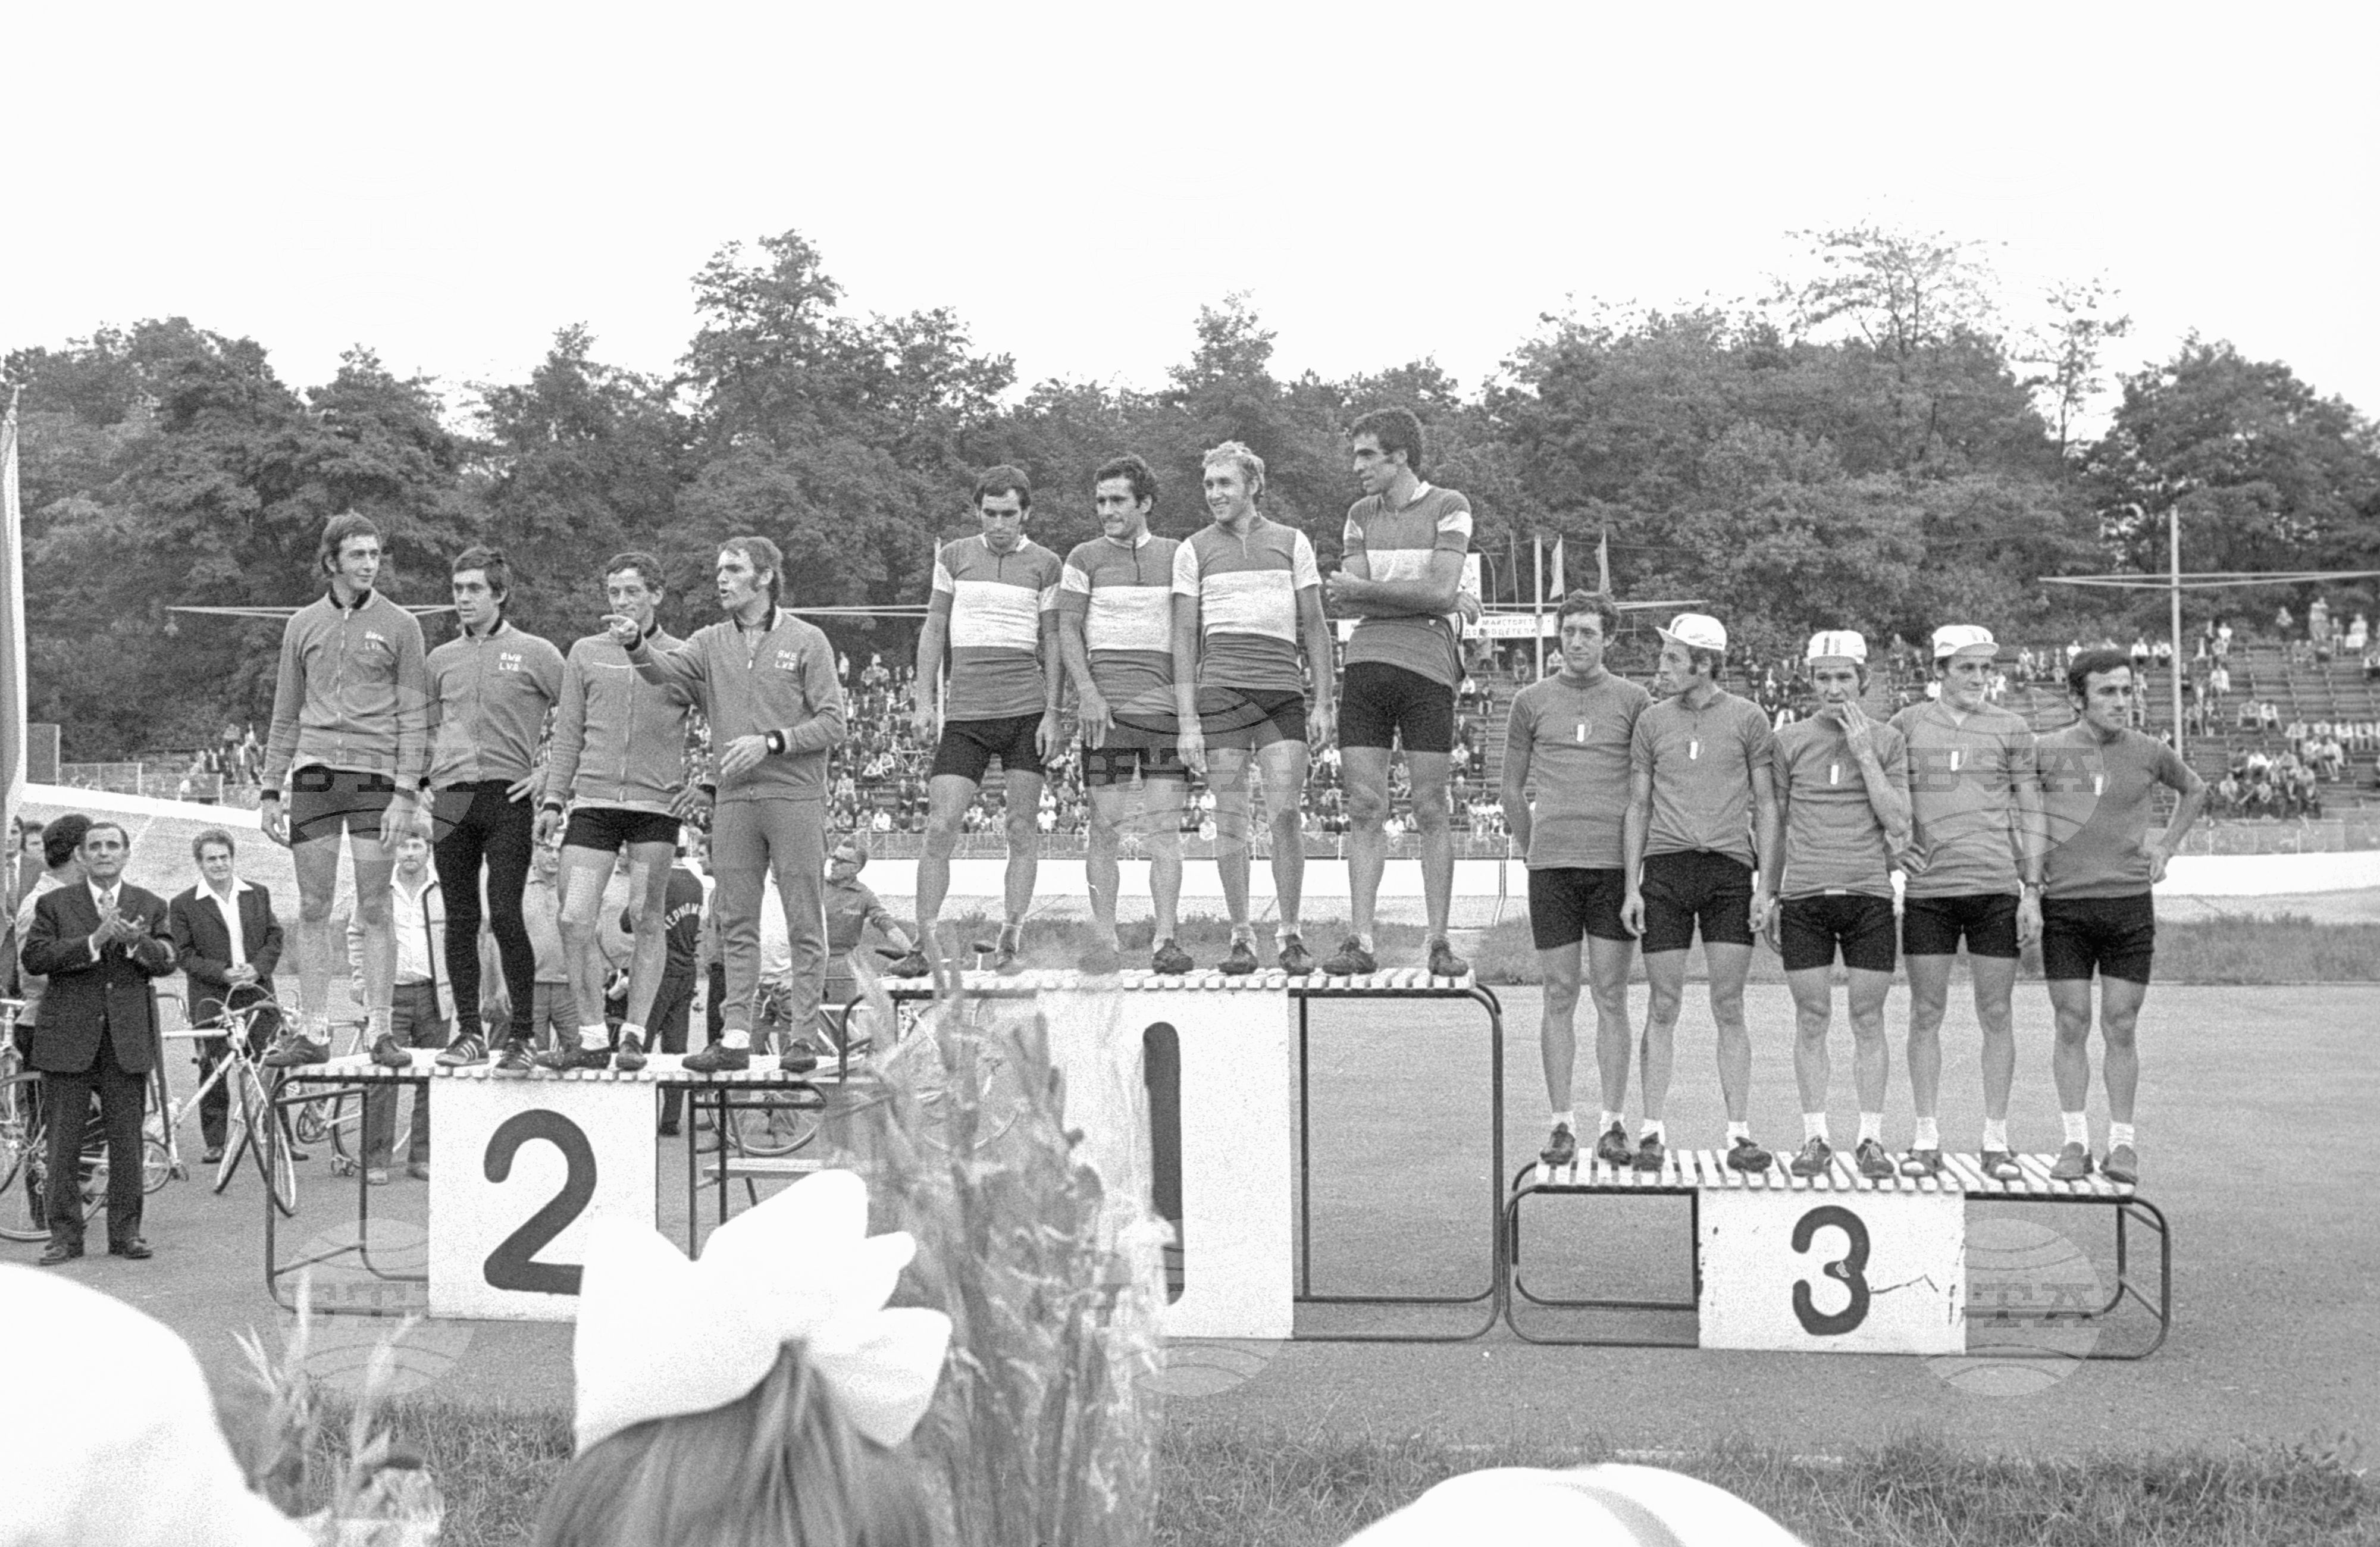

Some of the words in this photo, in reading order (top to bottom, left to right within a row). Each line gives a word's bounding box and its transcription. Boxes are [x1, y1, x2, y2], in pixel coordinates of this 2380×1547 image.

[484, 1108, 597, 1296] 2
[1143, 1021, 1185, 1306] 1
[1792, 1204, 1871, 1336] 3
